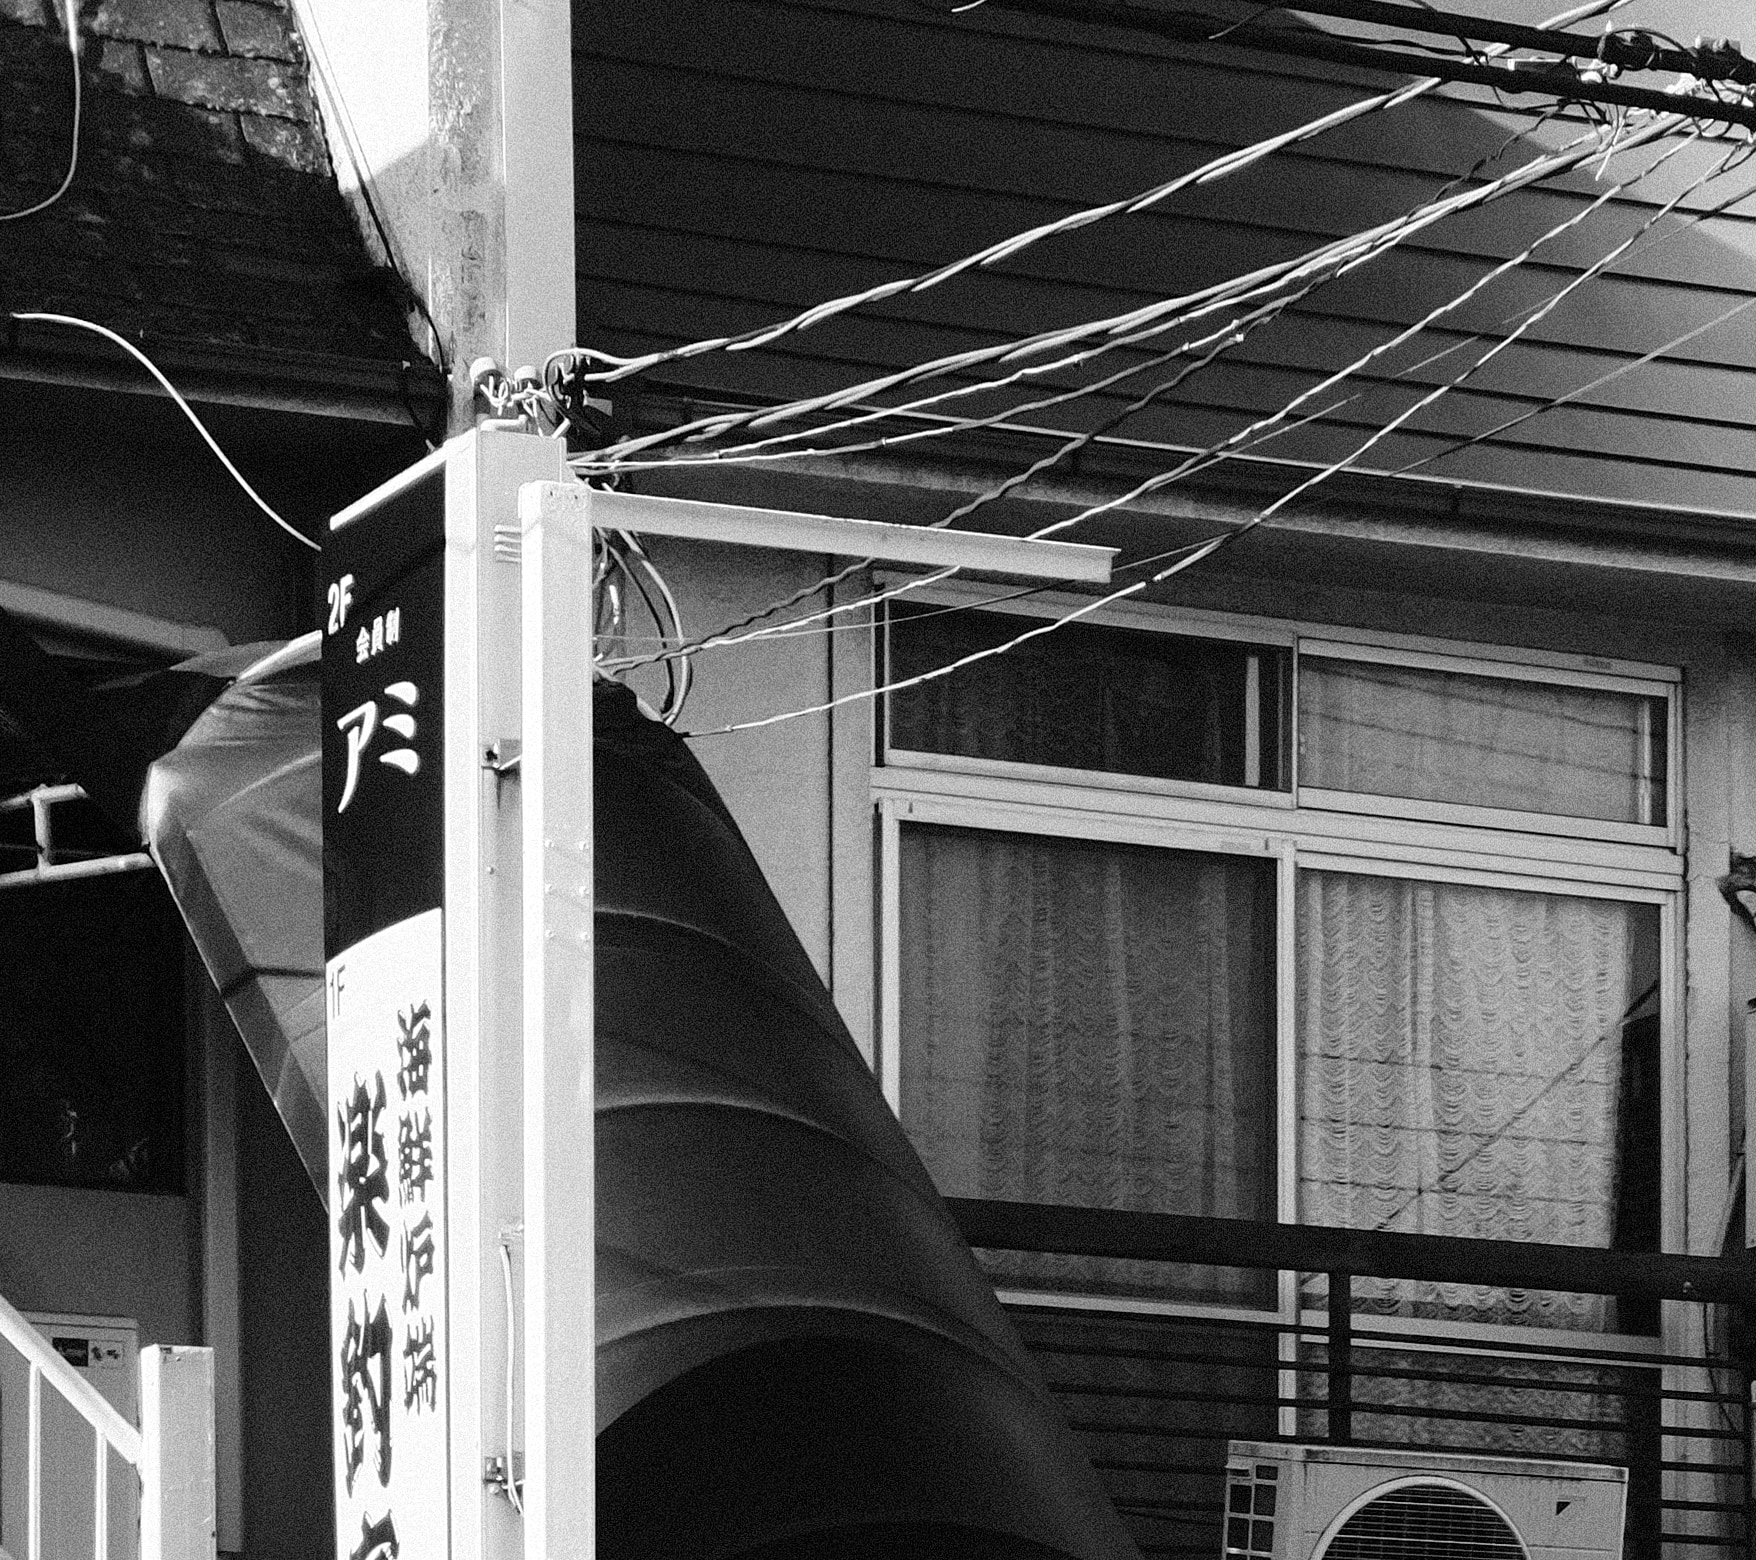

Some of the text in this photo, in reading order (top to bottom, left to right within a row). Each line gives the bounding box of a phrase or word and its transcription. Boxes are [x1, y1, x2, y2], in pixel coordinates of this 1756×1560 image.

[328, 573, 355, 635] 2F
[356, 606, 400, 665] 会員制
[336, 681, 420, 814] アミ
